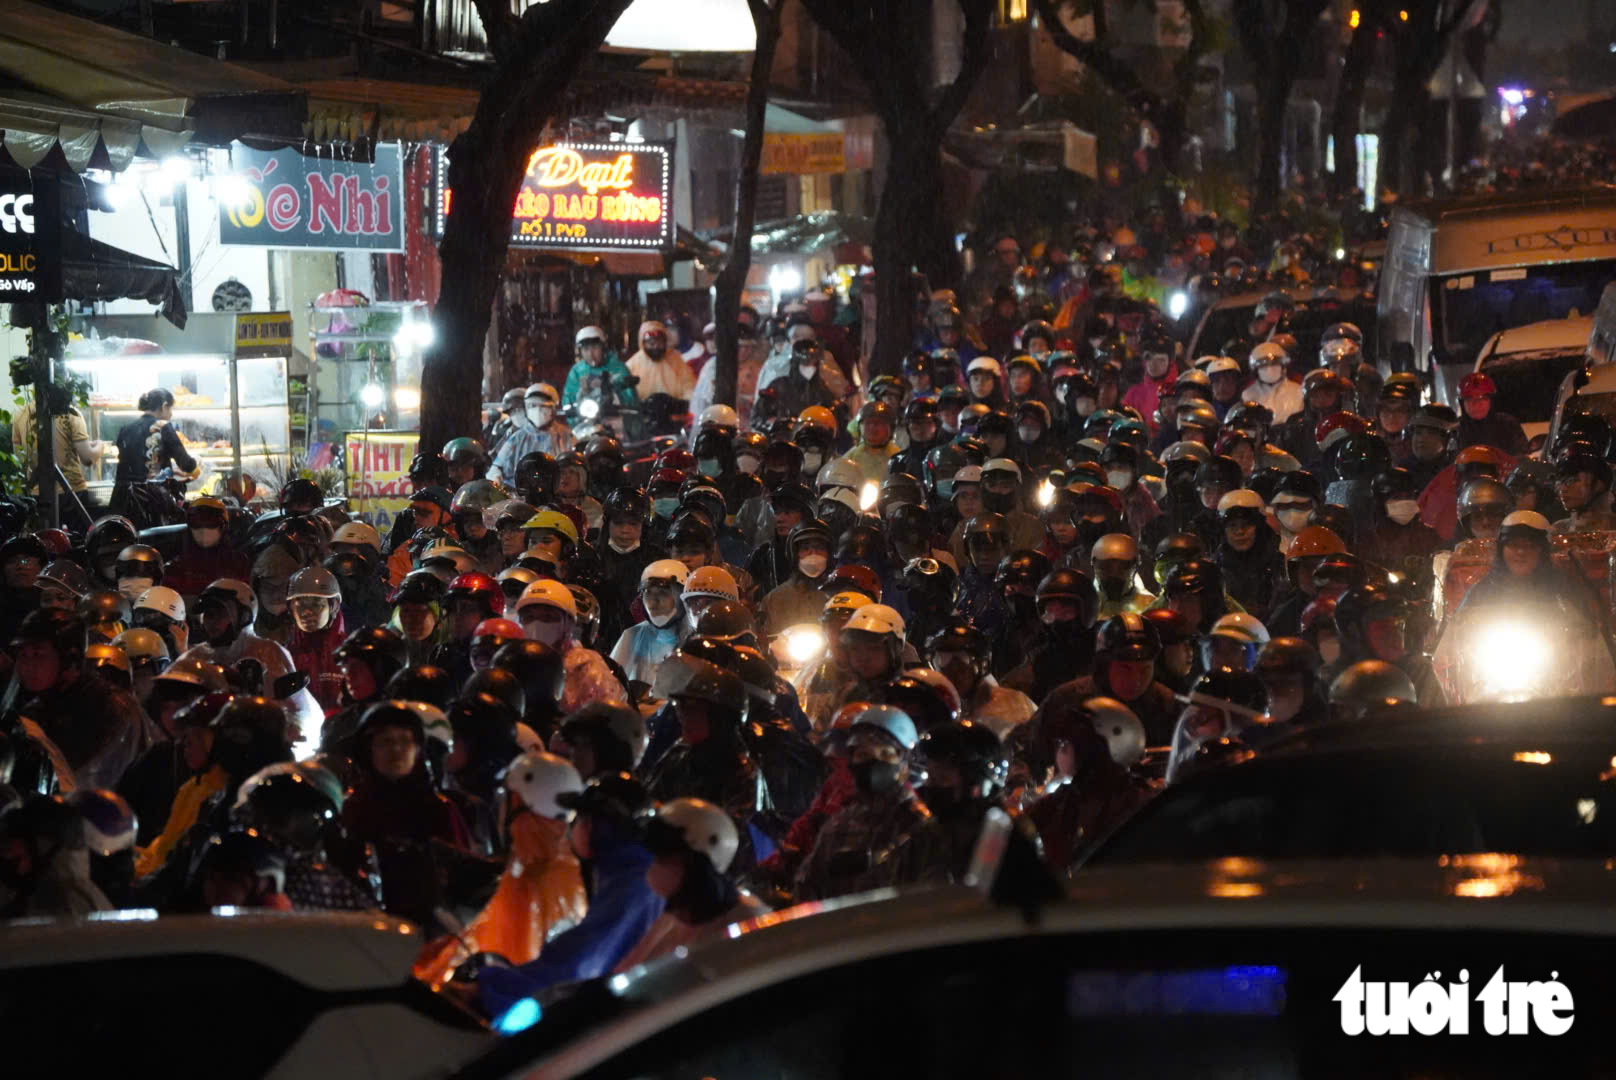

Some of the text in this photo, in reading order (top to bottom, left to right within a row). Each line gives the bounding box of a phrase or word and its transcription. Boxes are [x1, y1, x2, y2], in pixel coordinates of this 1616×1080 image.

[306, 172, 392, 235] Nhi
[553, 193, 598, 219] RAU
[13, 279, 36, 293] Vấp
